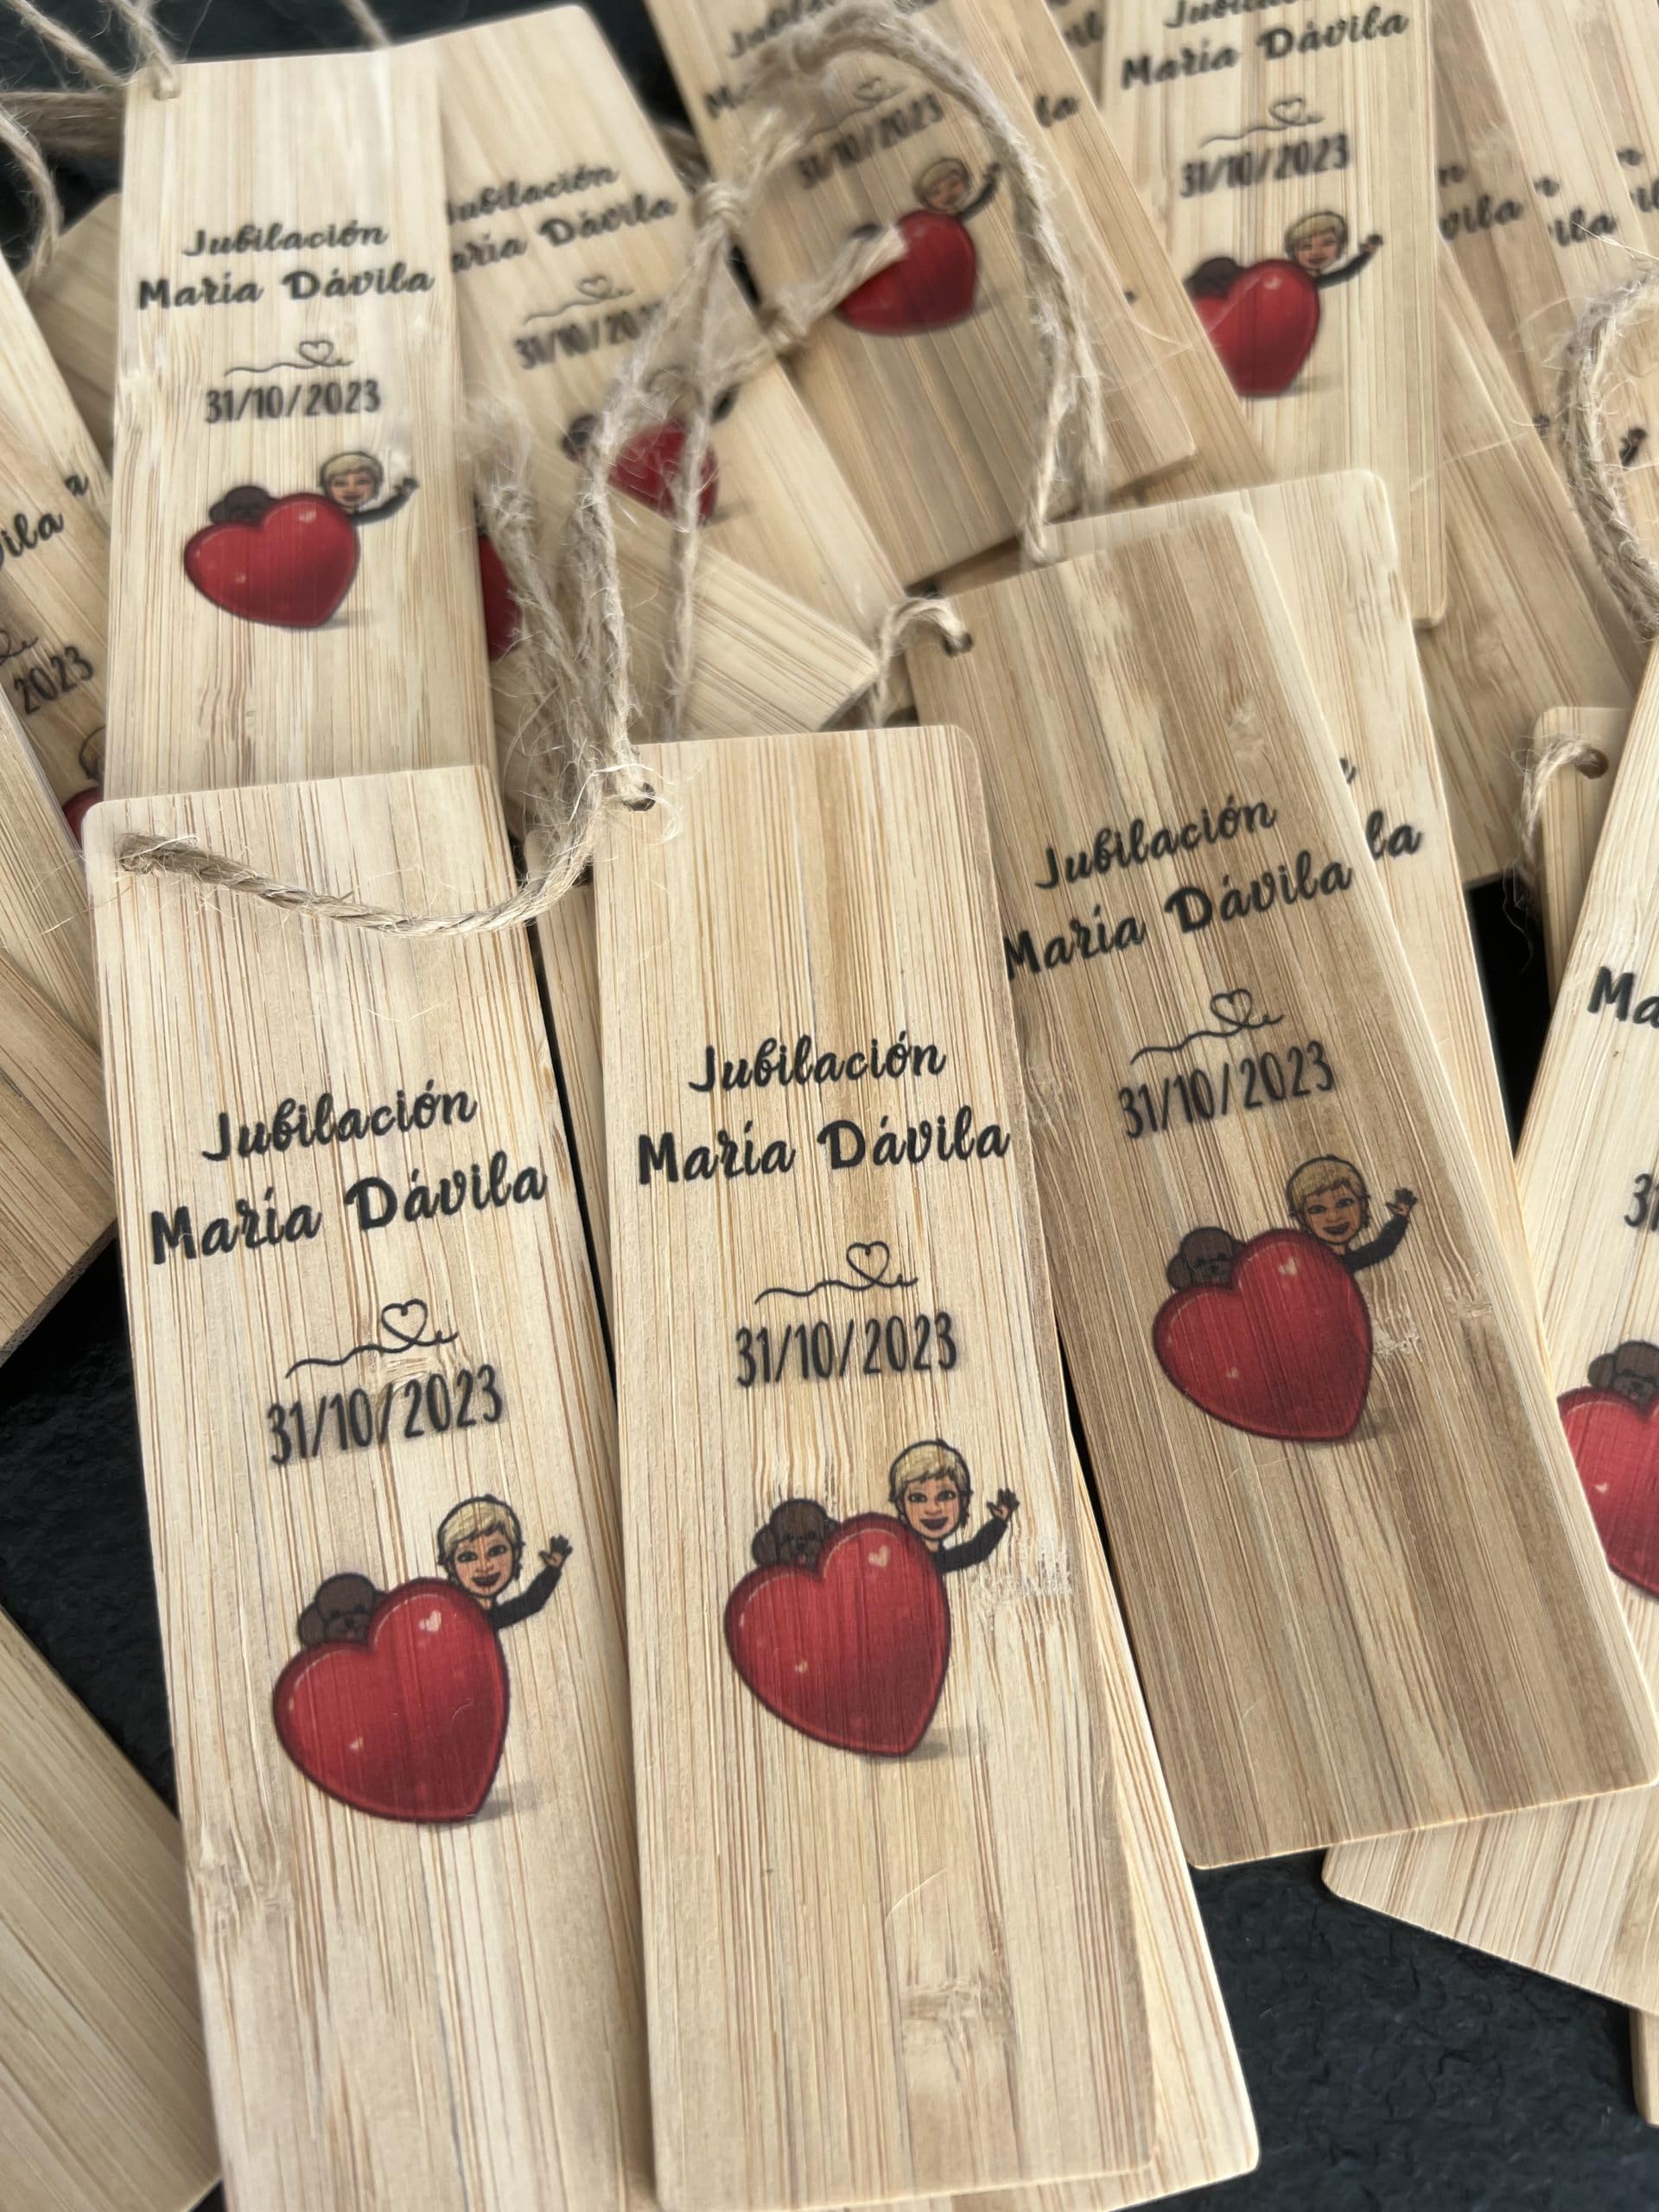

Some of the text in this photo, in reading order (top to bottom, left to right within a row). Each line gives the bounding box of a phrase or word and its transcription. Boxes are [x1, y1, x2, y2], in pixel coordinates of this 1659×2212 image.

[1121, 38, 1241, 89] María
[1256, 4, 1409, 61] Dávila
[1179, 131, 1351, 199] 31/10/2023
[181, 219, 389, 257] Jubilación
[451, 193, 677, 272] aría Dávila
[1439, 194, 1524, 241] vila
[137, 261, 435, 310] María Dávila
[204, 378, 382, 424] 31/10/2023
[1035, 794, 1278, 890] Jubilación
[1002, 849, 1354, 981] María Dávila
[688, 1030, 947, 1093] Jubilación
[1117, 1039, 1335, 1140] 31/10/2023
[201, 1079, 478, 1162] Jubilación
[638, 1105, 1012, 1185] María Dávila
[150, 1150, 549, 1266] María Dávila
[734, 1311, 958, 1389] 31/10/2023
[267, 1363, 504, 1466] 31/10/2023
